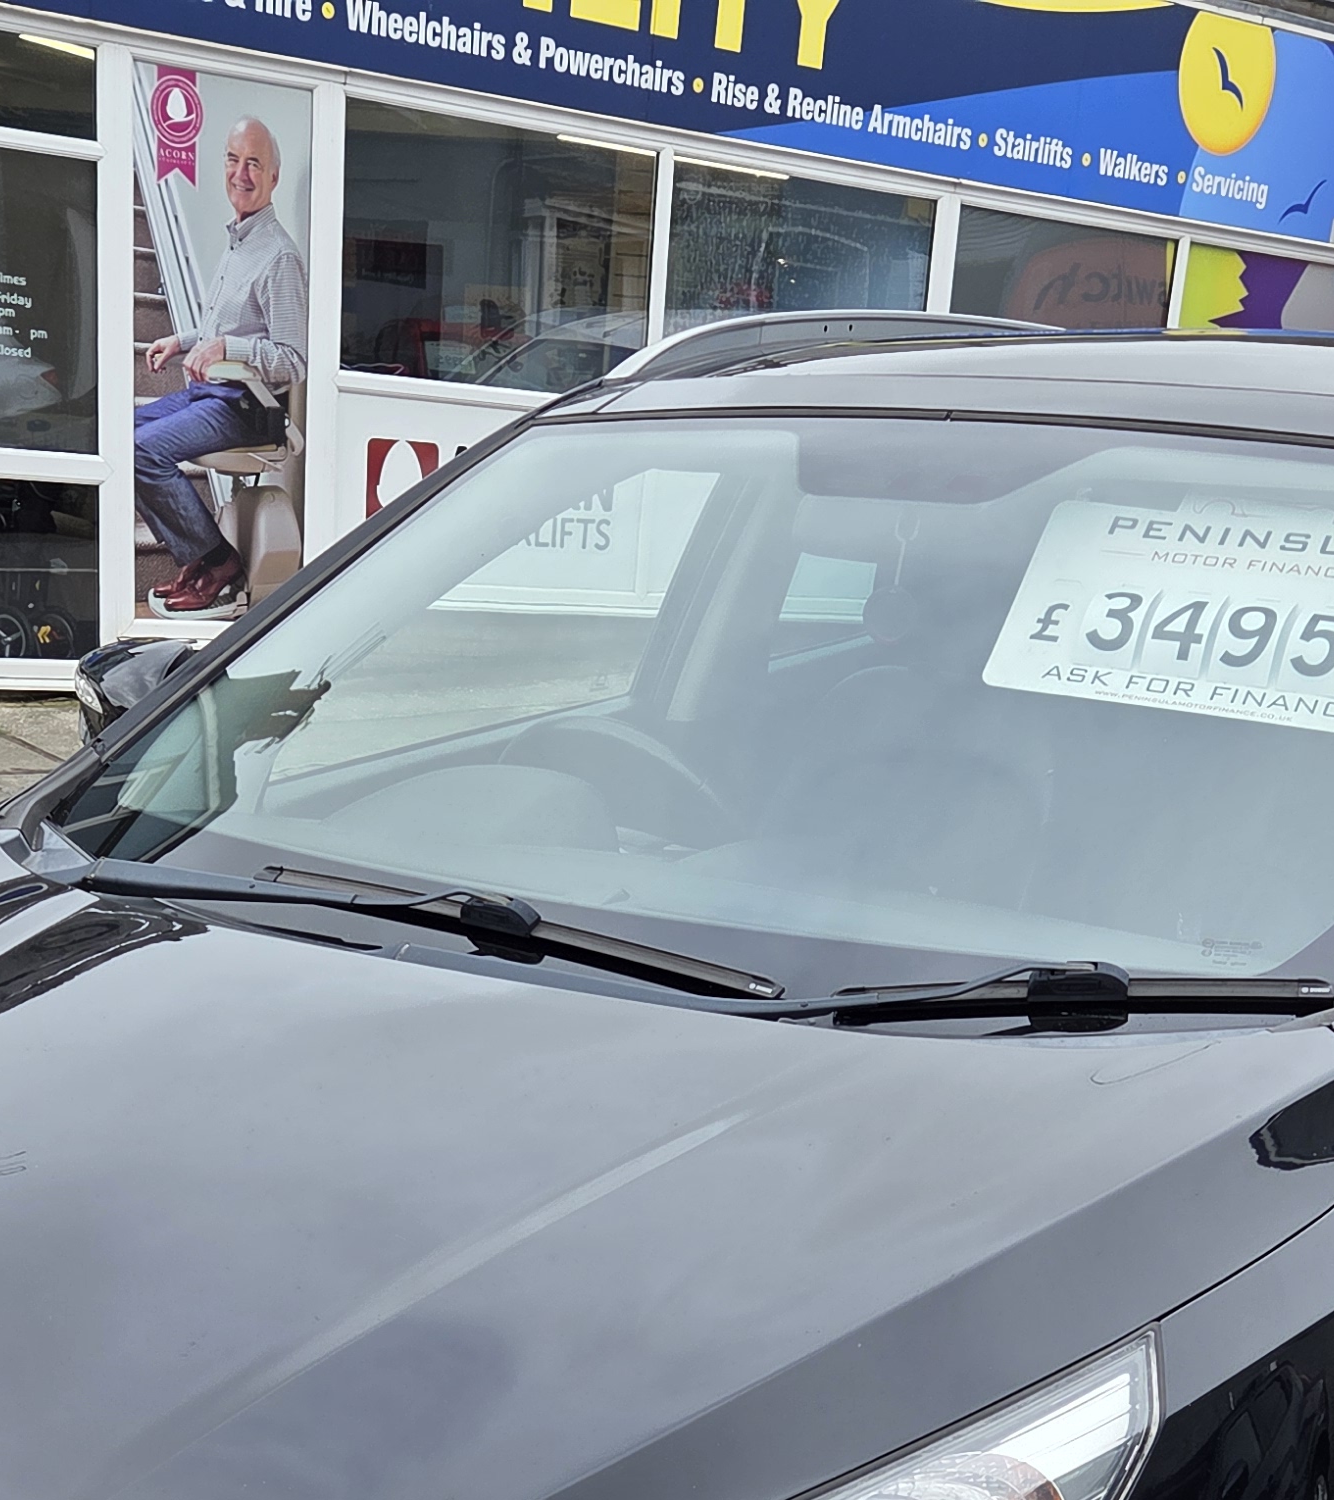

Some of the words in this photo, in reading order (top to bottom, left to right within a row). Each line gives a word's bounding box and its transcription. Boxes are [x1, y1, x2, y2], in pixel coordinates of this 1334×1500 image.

[345, 0, 505, 61] Wheelchairs
[512, 31, 532, 67] &
[538, 35, 685, 96] Powerchairs
[710, 71, 759, 111] Rise
[763, 82, 781, 115] &
[785, 86, 865, 131] Recline
[867, 103, 972, 151] Armchairs
[992, 127, 1073, 169] Stairlifts
[1098, 147, 1169, 187] Walkers
[1191, 166, 1269, 210] Servicing
[158, 147, 196, 161] ACORN
[29, 328, 48, 341] pm
[1150, 550, 1238, 570] MOTOR
[1041, 665, 1113, 687] ASK
[1124, 675, 1196, 698] FOR
